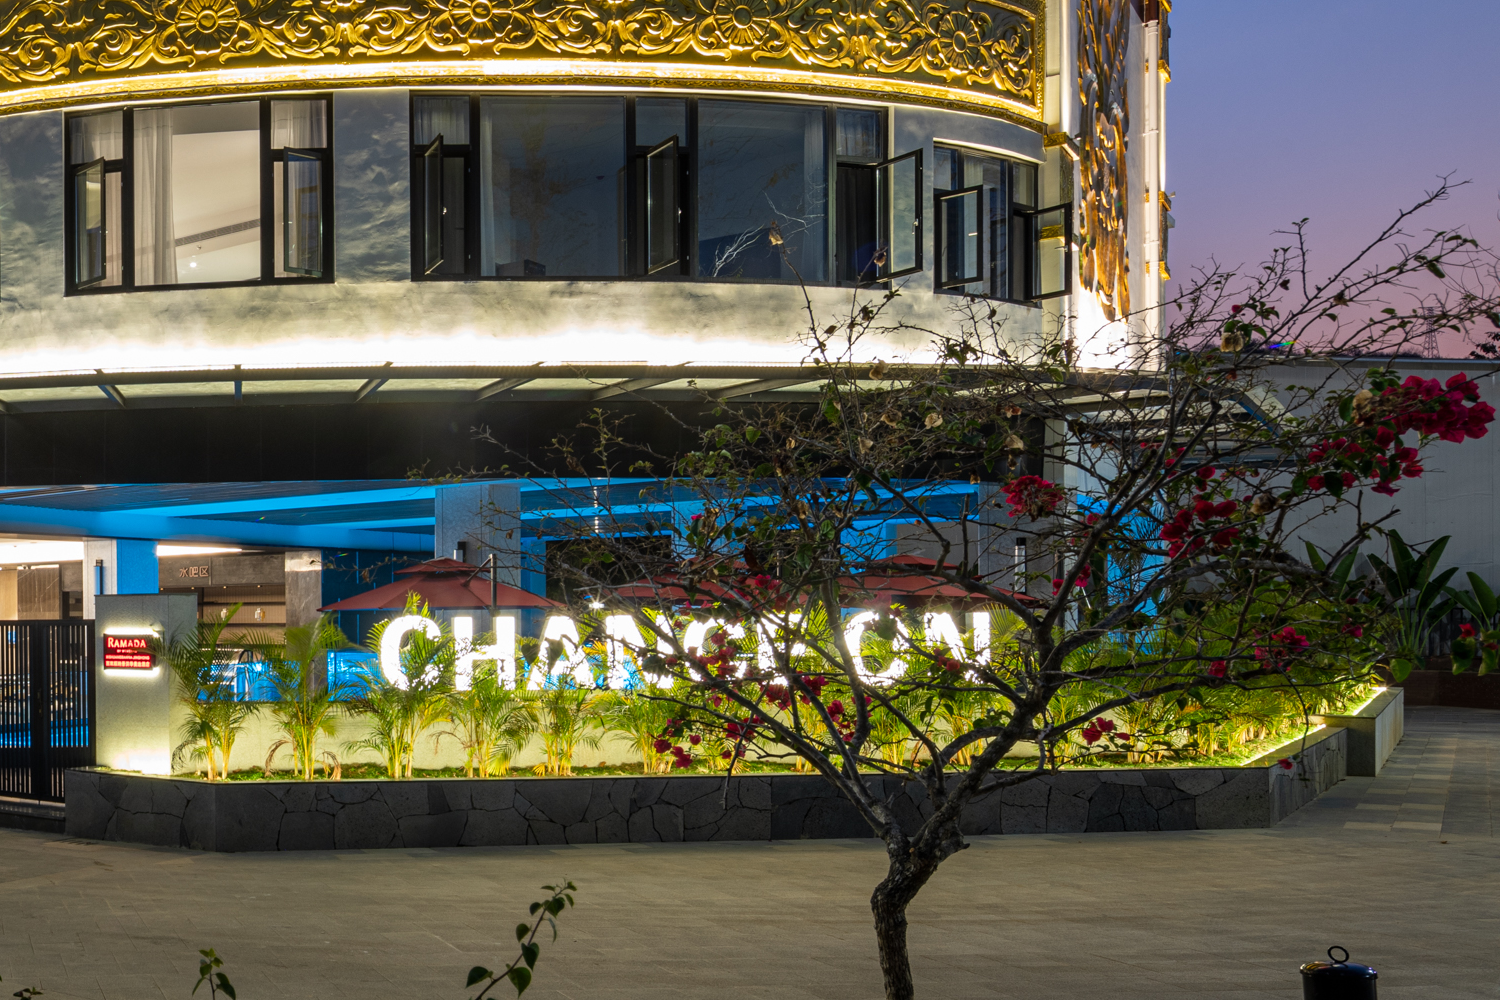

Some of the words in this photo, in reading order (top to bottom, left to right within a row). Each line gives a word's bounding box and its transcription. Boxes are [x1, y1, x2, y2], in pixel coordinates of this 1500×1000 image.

[179, 565, 209, 578] 水吧区
[107, 636, 147, 648] RAMADA
